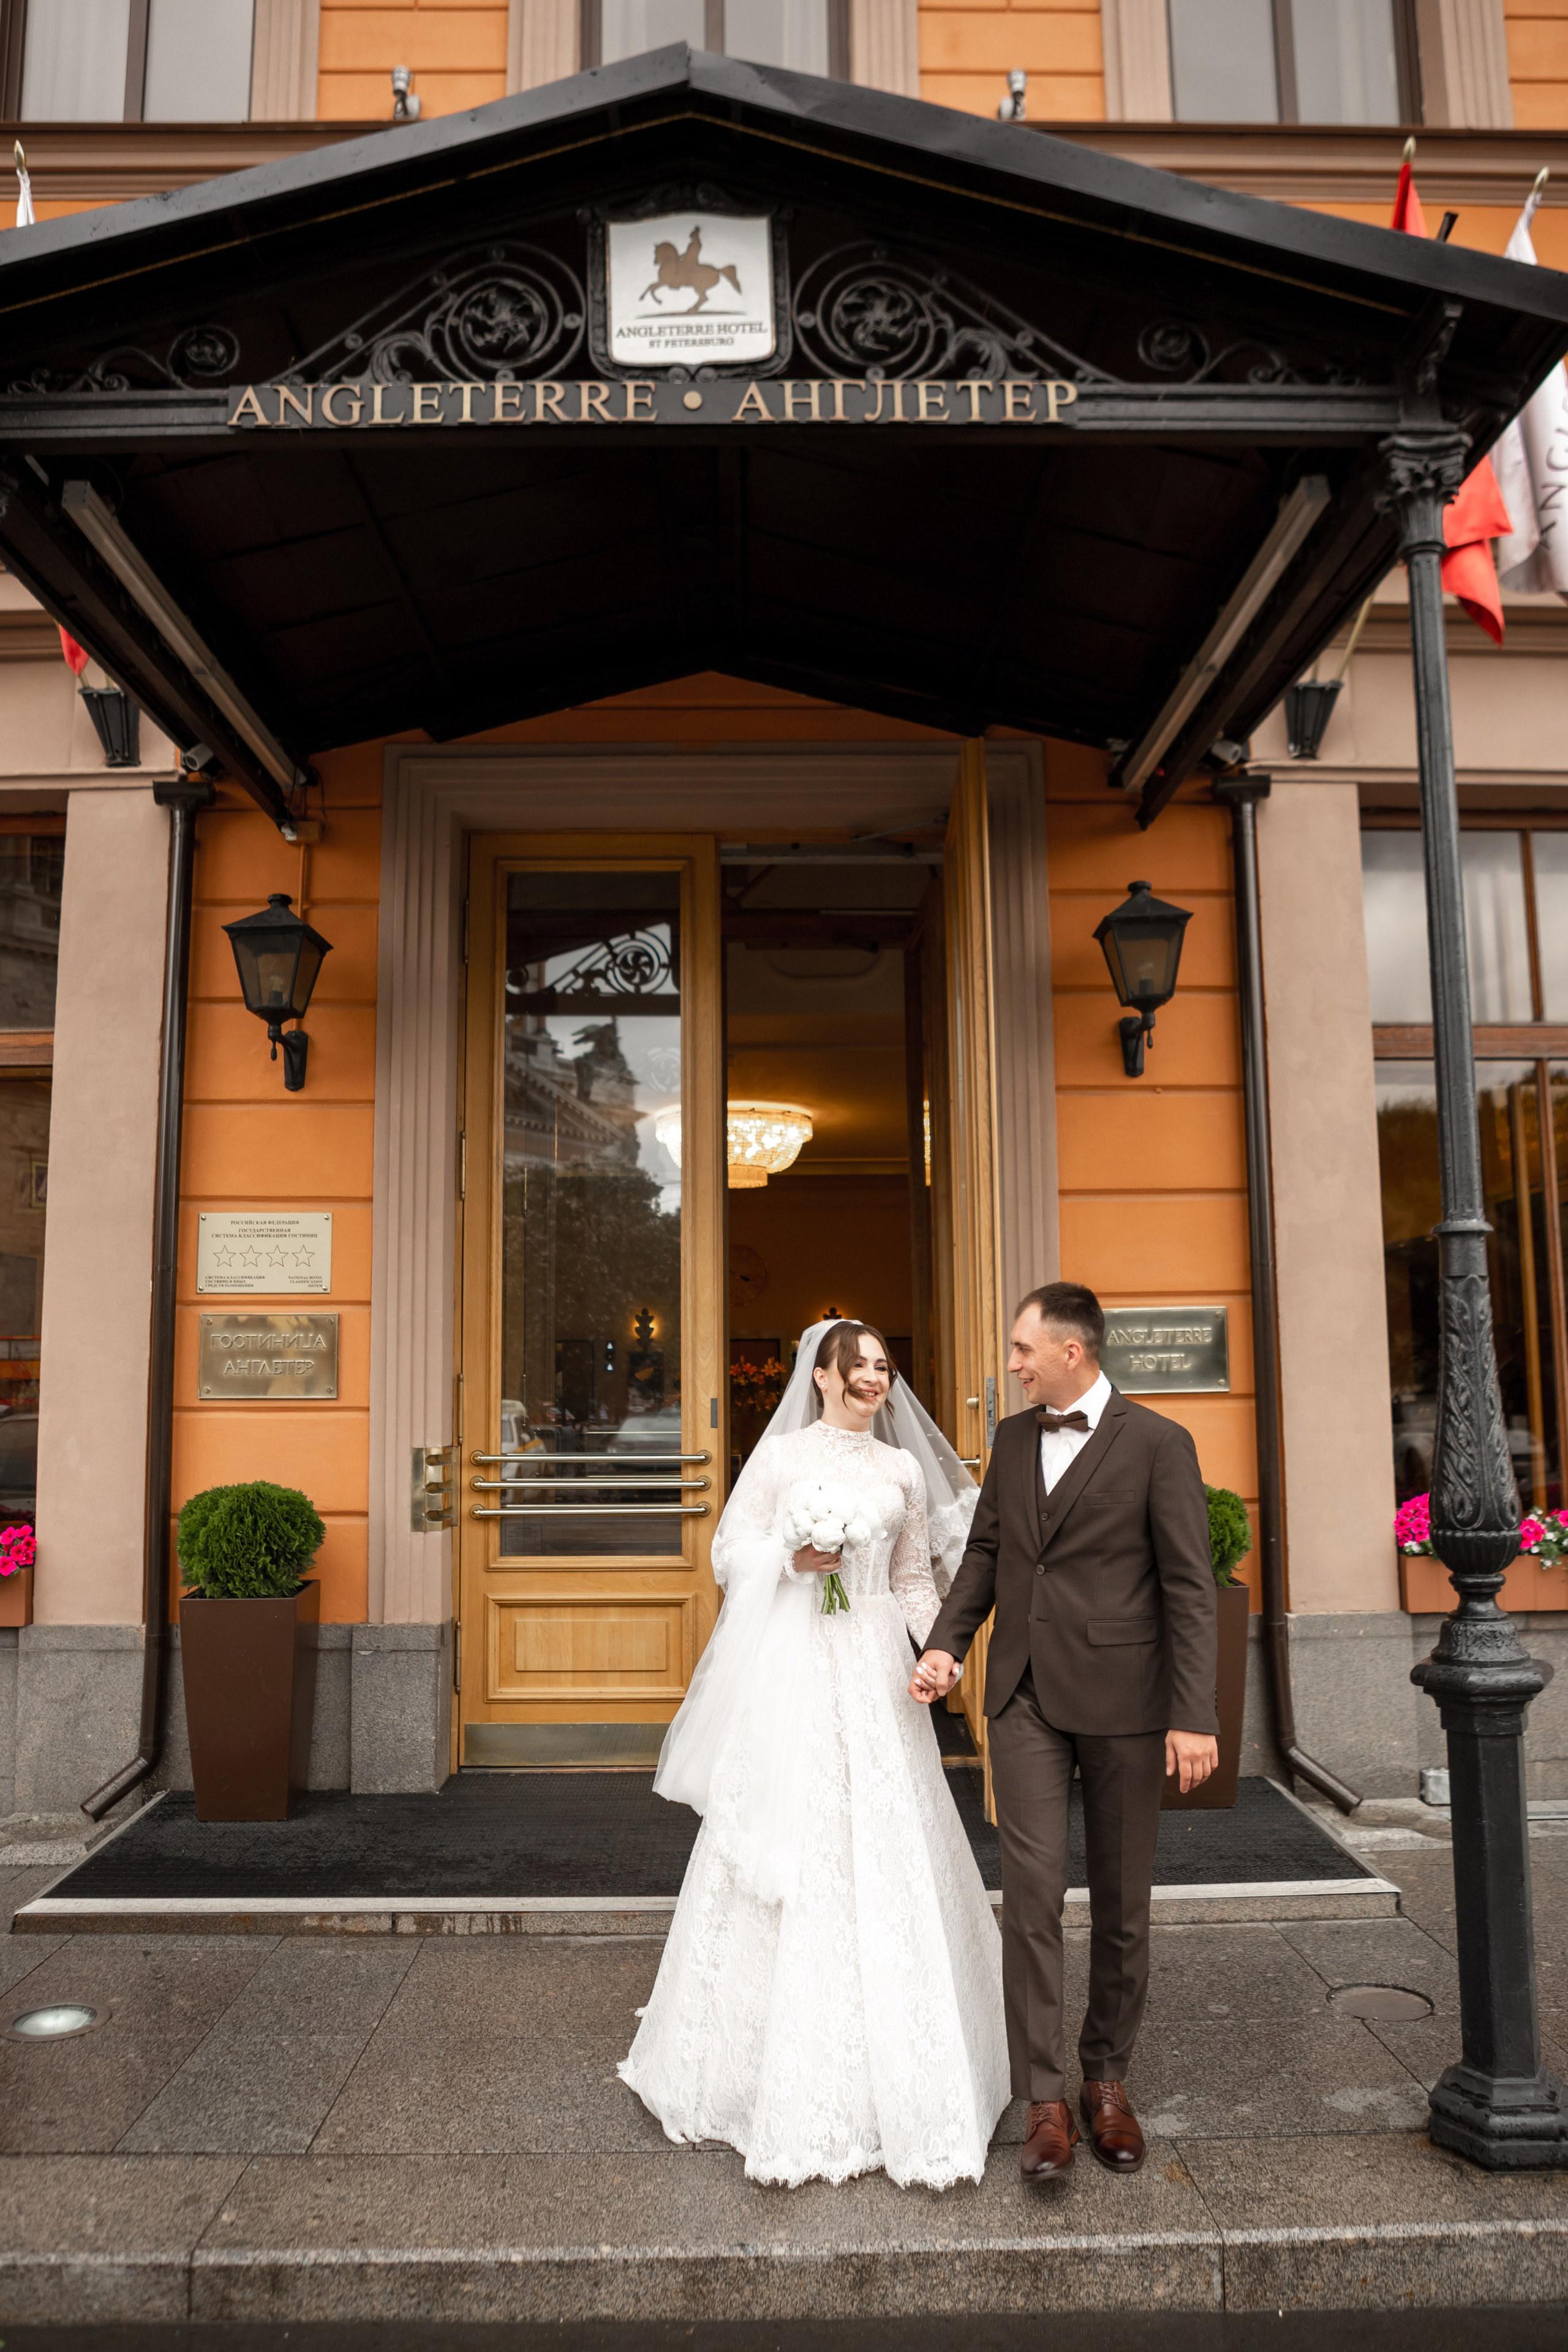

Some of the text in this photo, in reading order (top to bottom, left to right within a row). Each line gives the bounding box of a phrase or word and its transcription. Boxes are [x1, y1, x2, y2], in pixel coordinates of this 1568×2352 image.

[615, 321, 768, 337] ANGLETERRE HOTEL
[649, 337, 734, 349] ST PETERSBURG
[227, 380, 659, 427] ANGLETERRE
[731, 379, 1078, 424] АНГЛЕТЕР
[211, 1334, 326, 1349] ГОСТИНИЦА
[1106, 1327, 1213, 1346] ANGLETERRE
[223, 1360, 315, 1375] АНГЛЕТЕР
[1129, 1353, 1191, 1371] HOTEL
